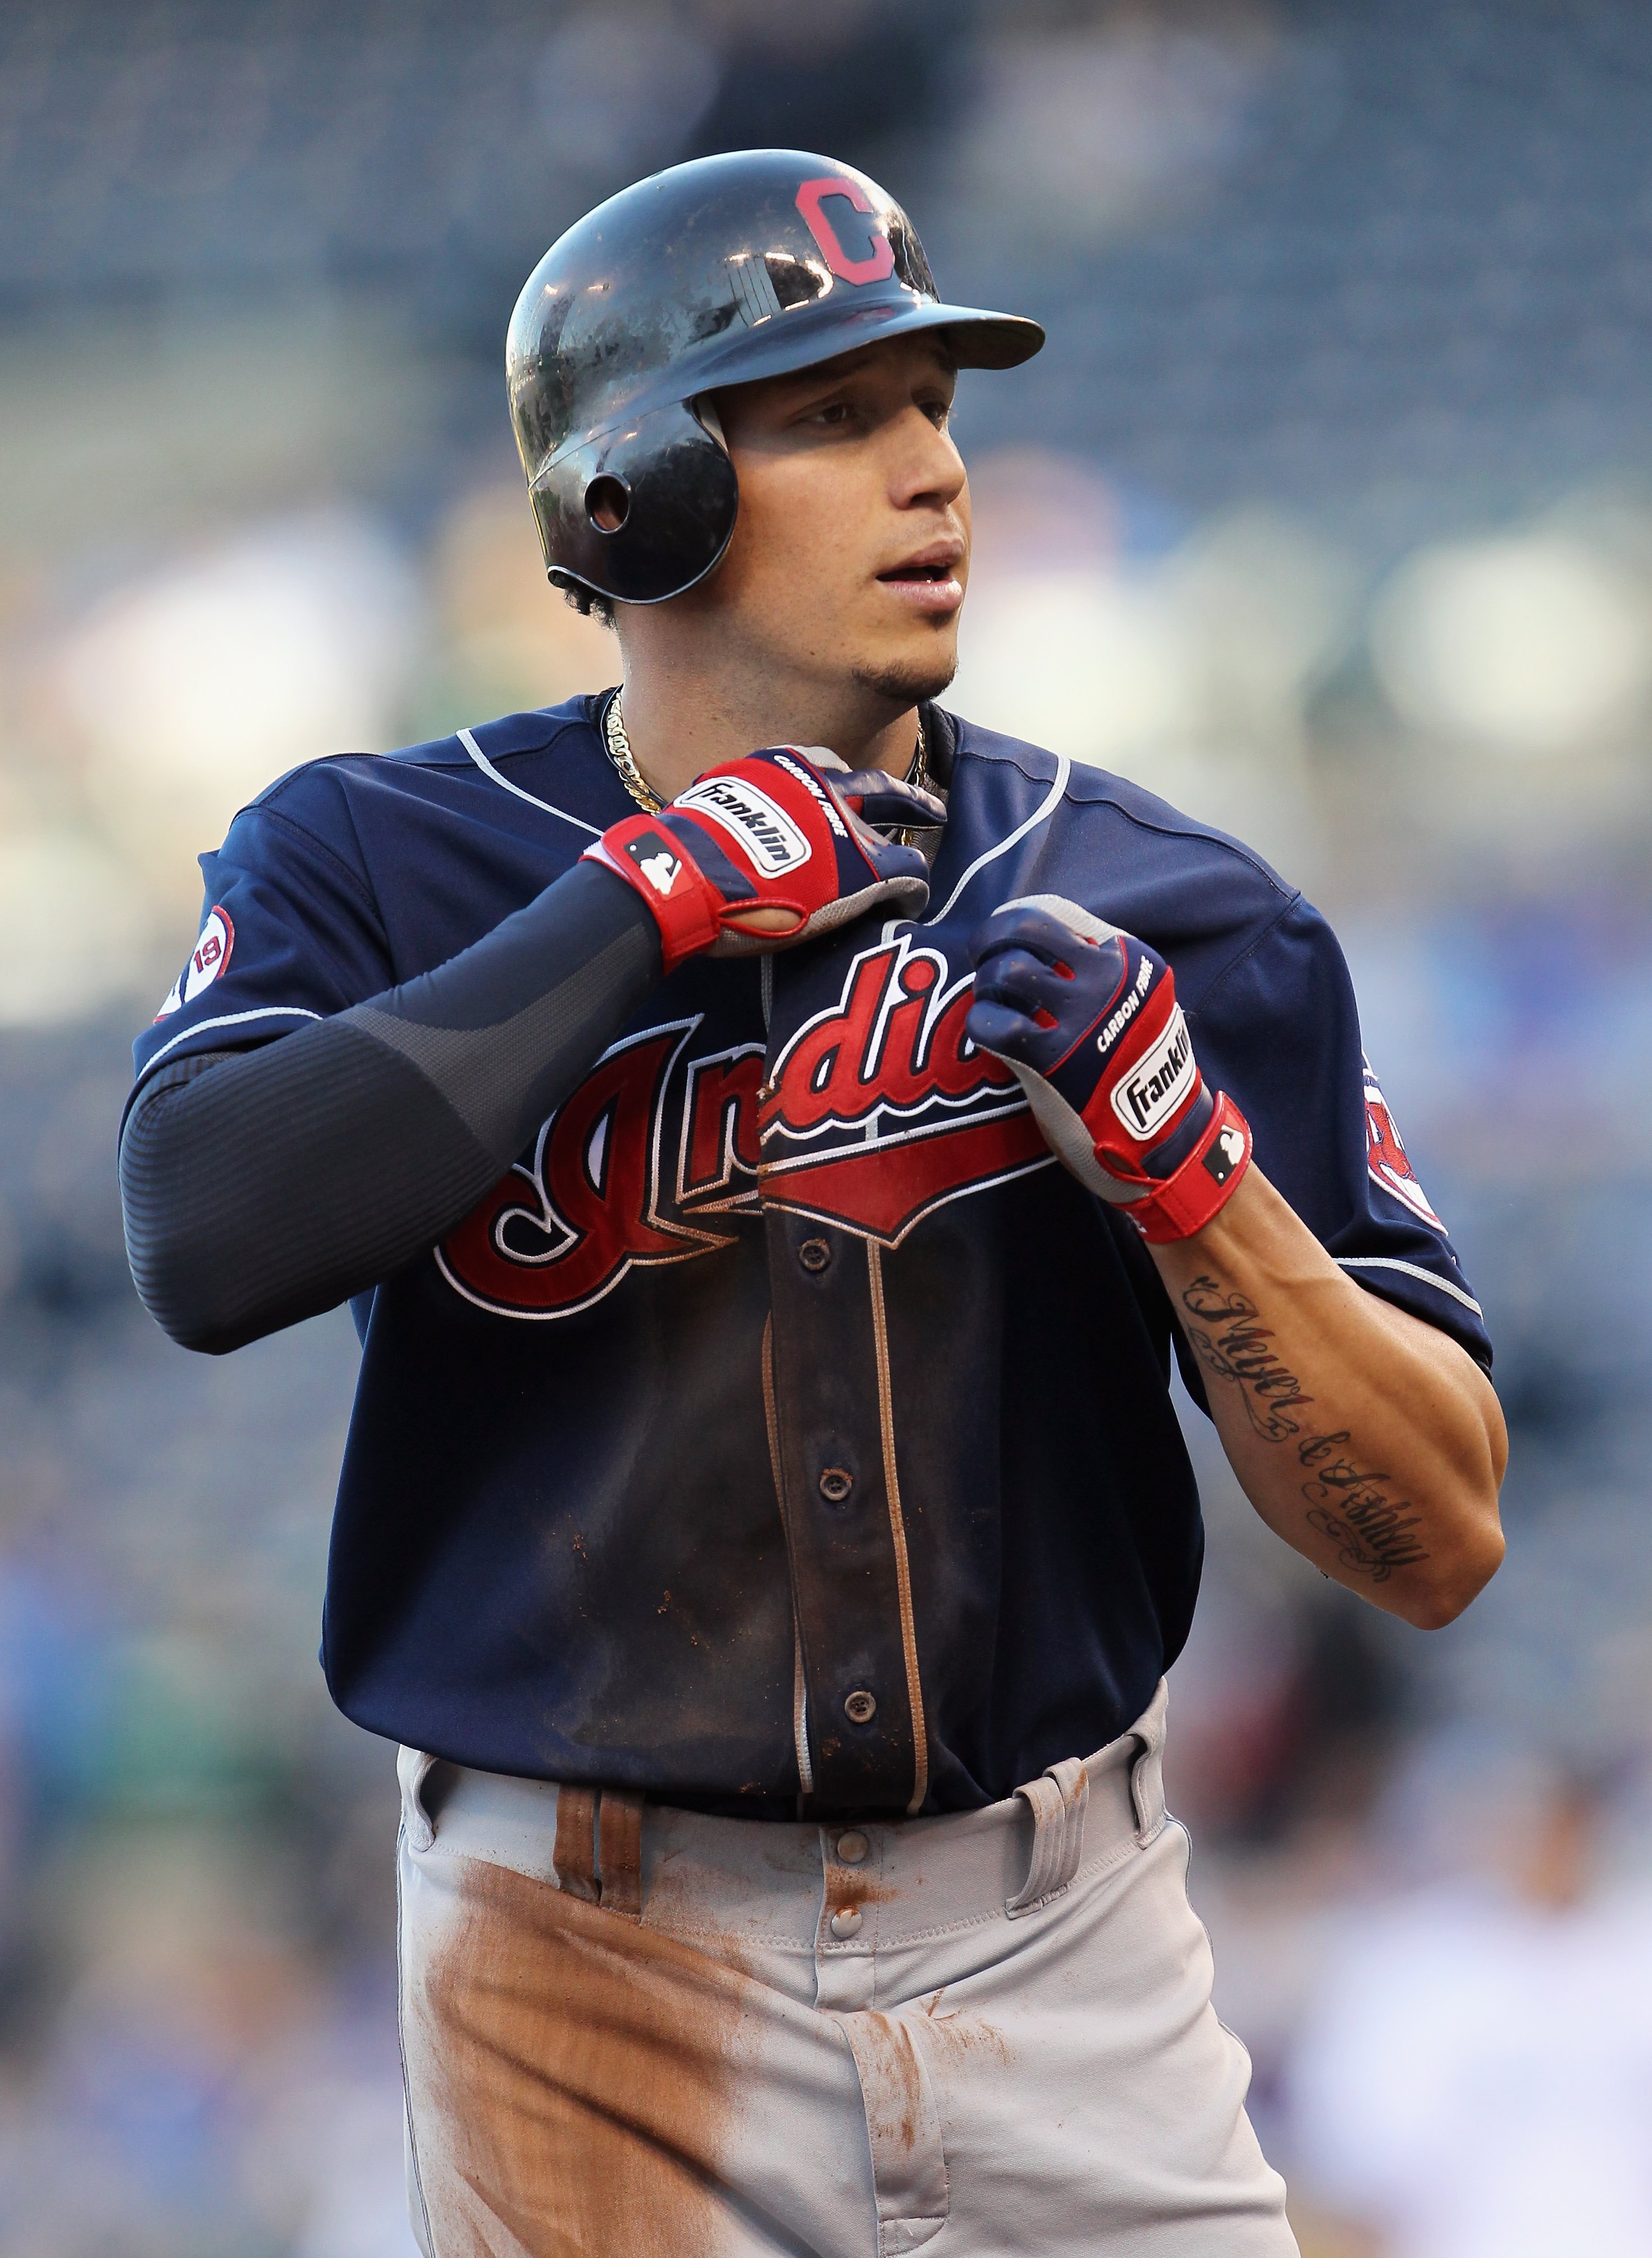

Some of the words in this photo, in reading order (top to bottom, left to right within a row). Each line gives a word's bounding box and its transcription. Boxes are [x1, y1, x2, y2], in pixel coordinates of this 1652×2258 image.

[795, 177, 895, 286] C
[684, 782, 791, 861] Franklin
[774, 755, 826, 799] CARBON
[818, 799, 848, 838] FIBRE
[194, 936, 222, 973] 19
[1097, 990, 1140, 1053] CARBON
[1135, 954, 1154, 998] FIBRE
[435, 934, 1028, 1321] India
